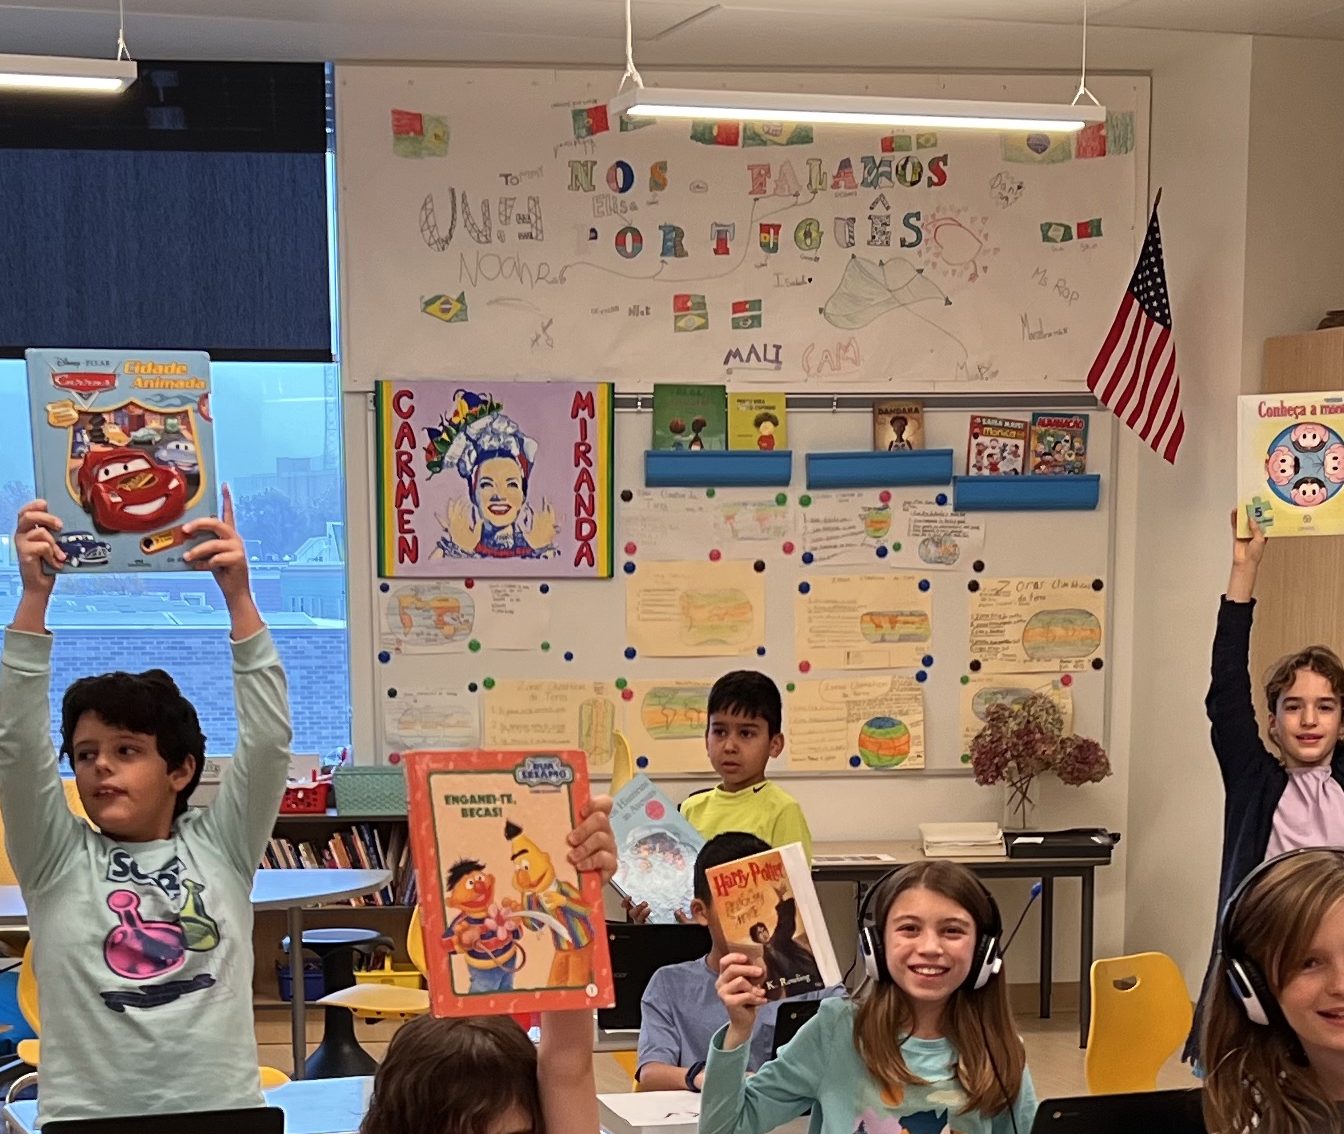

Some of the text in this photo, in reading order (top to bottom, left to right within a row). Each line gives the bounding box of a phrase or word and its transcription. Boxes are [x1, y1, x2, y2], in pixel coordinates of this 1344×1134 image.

[568, 154, 948, 195] NOS FALAMOS
[460, 250, 533, 289] Noah
[723, 344, 782, 370] MALI
[123, 360, 187, 375] Cidade
[132, 376, 206, 389] Animada
[878, 407, 920, 415] DANDARA
[1258, 400, 1307, 419] Conheça
[1310, 404, 1317, 415] a
[392, 390, 420, 564] CARMEN
[570, 390, 597, 568] MIRANDA
[1254, 507, 1263, 517] 5
[444, 794, 517, 805] ENGANEI-TE,
[461, 807, 503, 818] BECAS!
[713, 861, 785, 897] Harry Potter
[780, 973, 811, 987] Rowling
